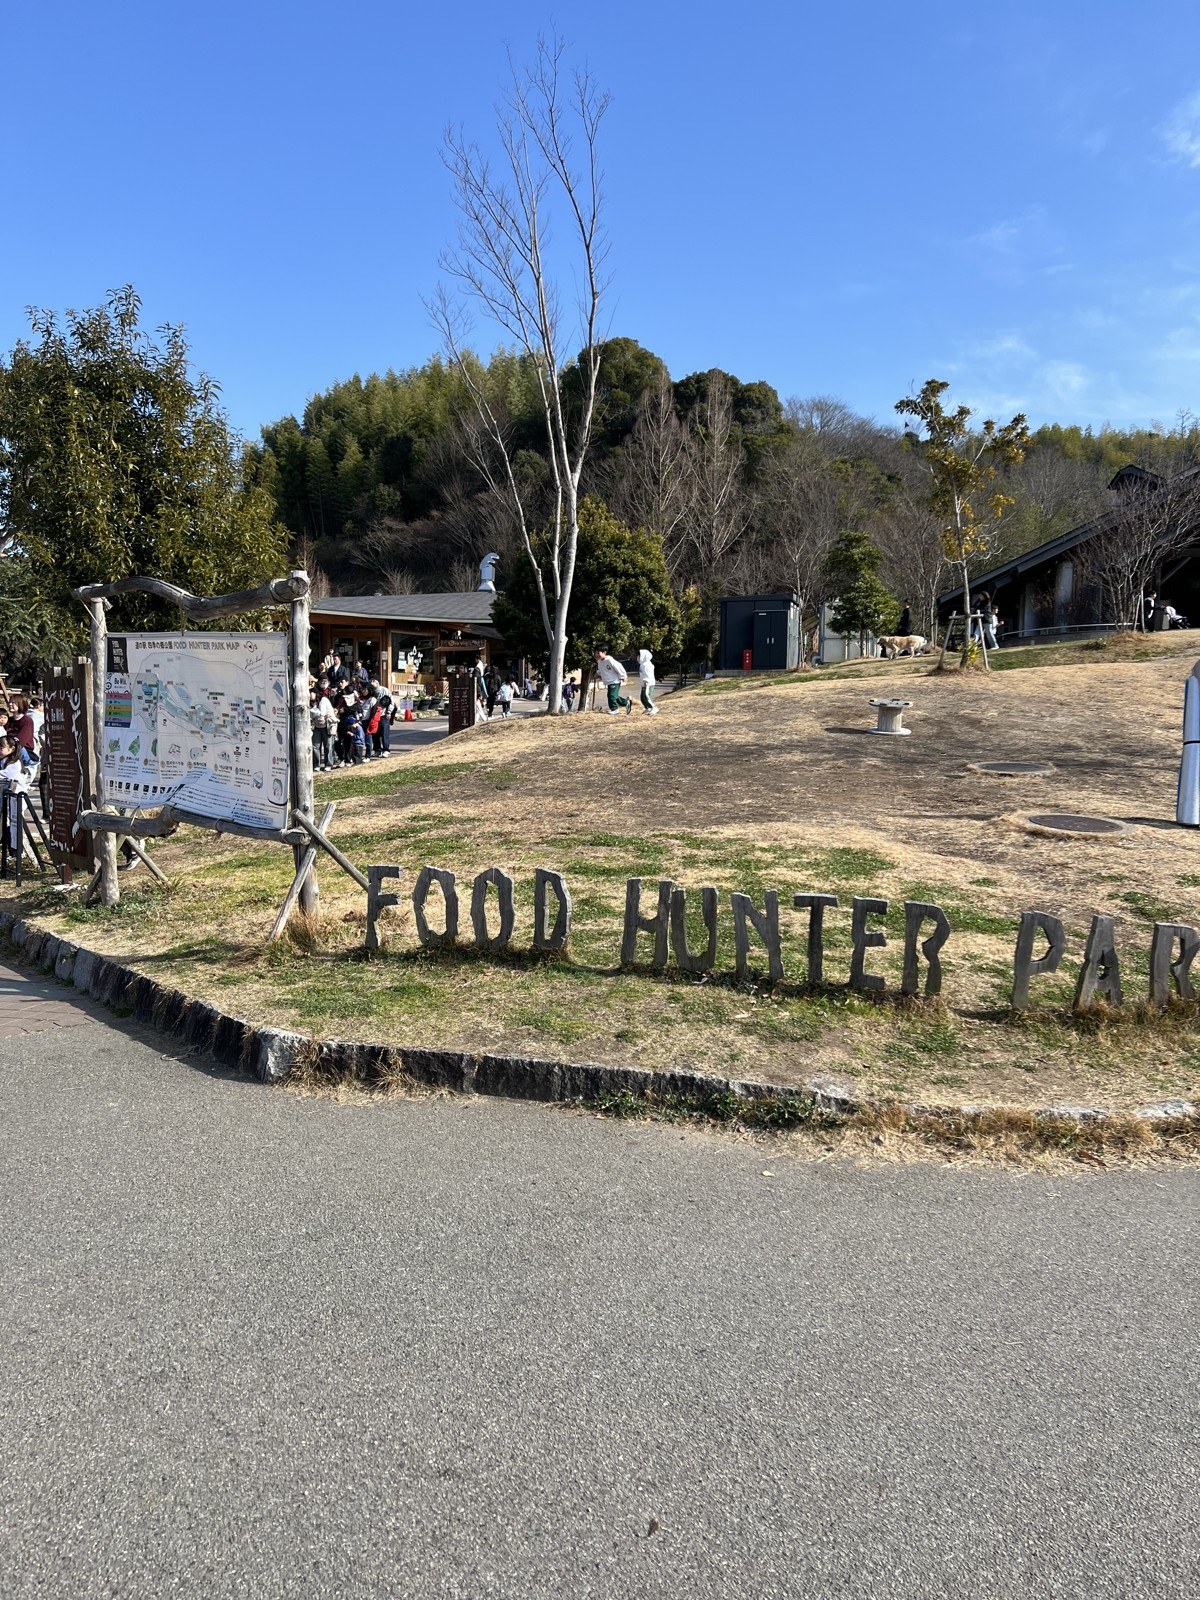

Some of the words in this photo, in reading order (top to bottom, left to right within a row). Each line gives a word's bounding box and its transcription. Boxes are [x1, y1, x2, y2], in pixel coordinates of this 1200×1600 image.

[174, 641, 187, 650] FOOD
[189, 641, 210, 650] HUNTER
[211, 641, 226, 650] PARK
[226, 641, 240, 650] MAP
[364, 864, 573, 951] FOOD
[619, 877, 951, 995] HUNTER
[1011, 909, 1200, 1011] PAR
